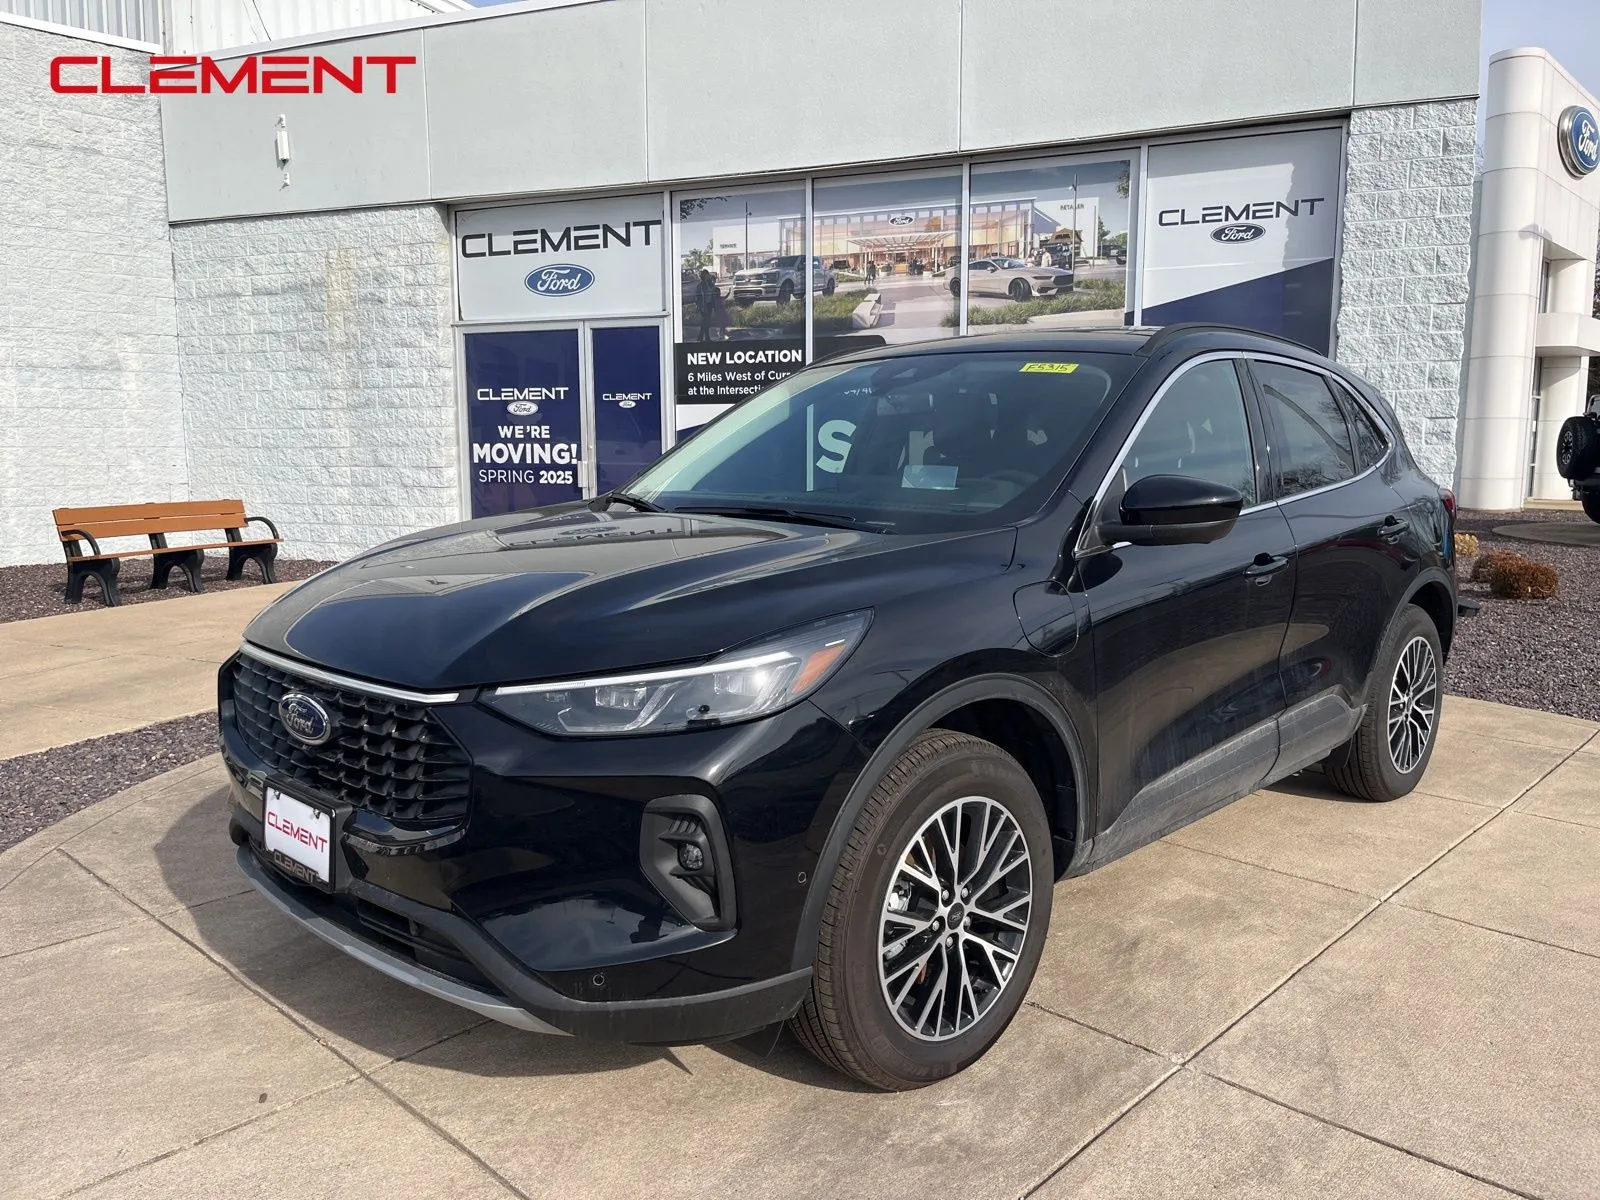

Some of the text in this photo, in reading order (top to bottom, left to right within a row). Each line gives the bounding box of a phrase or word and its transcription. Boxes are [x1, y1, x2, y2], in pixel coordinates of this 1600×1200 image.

[1578, 119, 1599, 162] Ford
[1060, 203, 1085, 211] RETALER
[1158, 197, 1325, 227] CLEMENT
[461, 219, 662, 259] CLEMENT
[1221, 226, 1254, 241] Ford
[536, 268, 582, 292] Ford
[687, 349, 803, 365] NEW LOCATION
[687, 372, 695, 382] 6
[697, 371, 722, 382] Miles
[725, 371, 752, 381] West
[754, 370, 766, 381] of
[477, 387, 569, 401] CLEMENT
[602, 392, 653, 401] CLEMENT
[688, 384, 763, 395] at the Intersecti
[513, 403, 532, 412] Ford
[472, 442, 578, 465] MOVING!
[479, 469, 574, 485] SPRING 2025
[286, 702, 314, 734] Ford
[267, 811, 328, 853] CLEMENT
